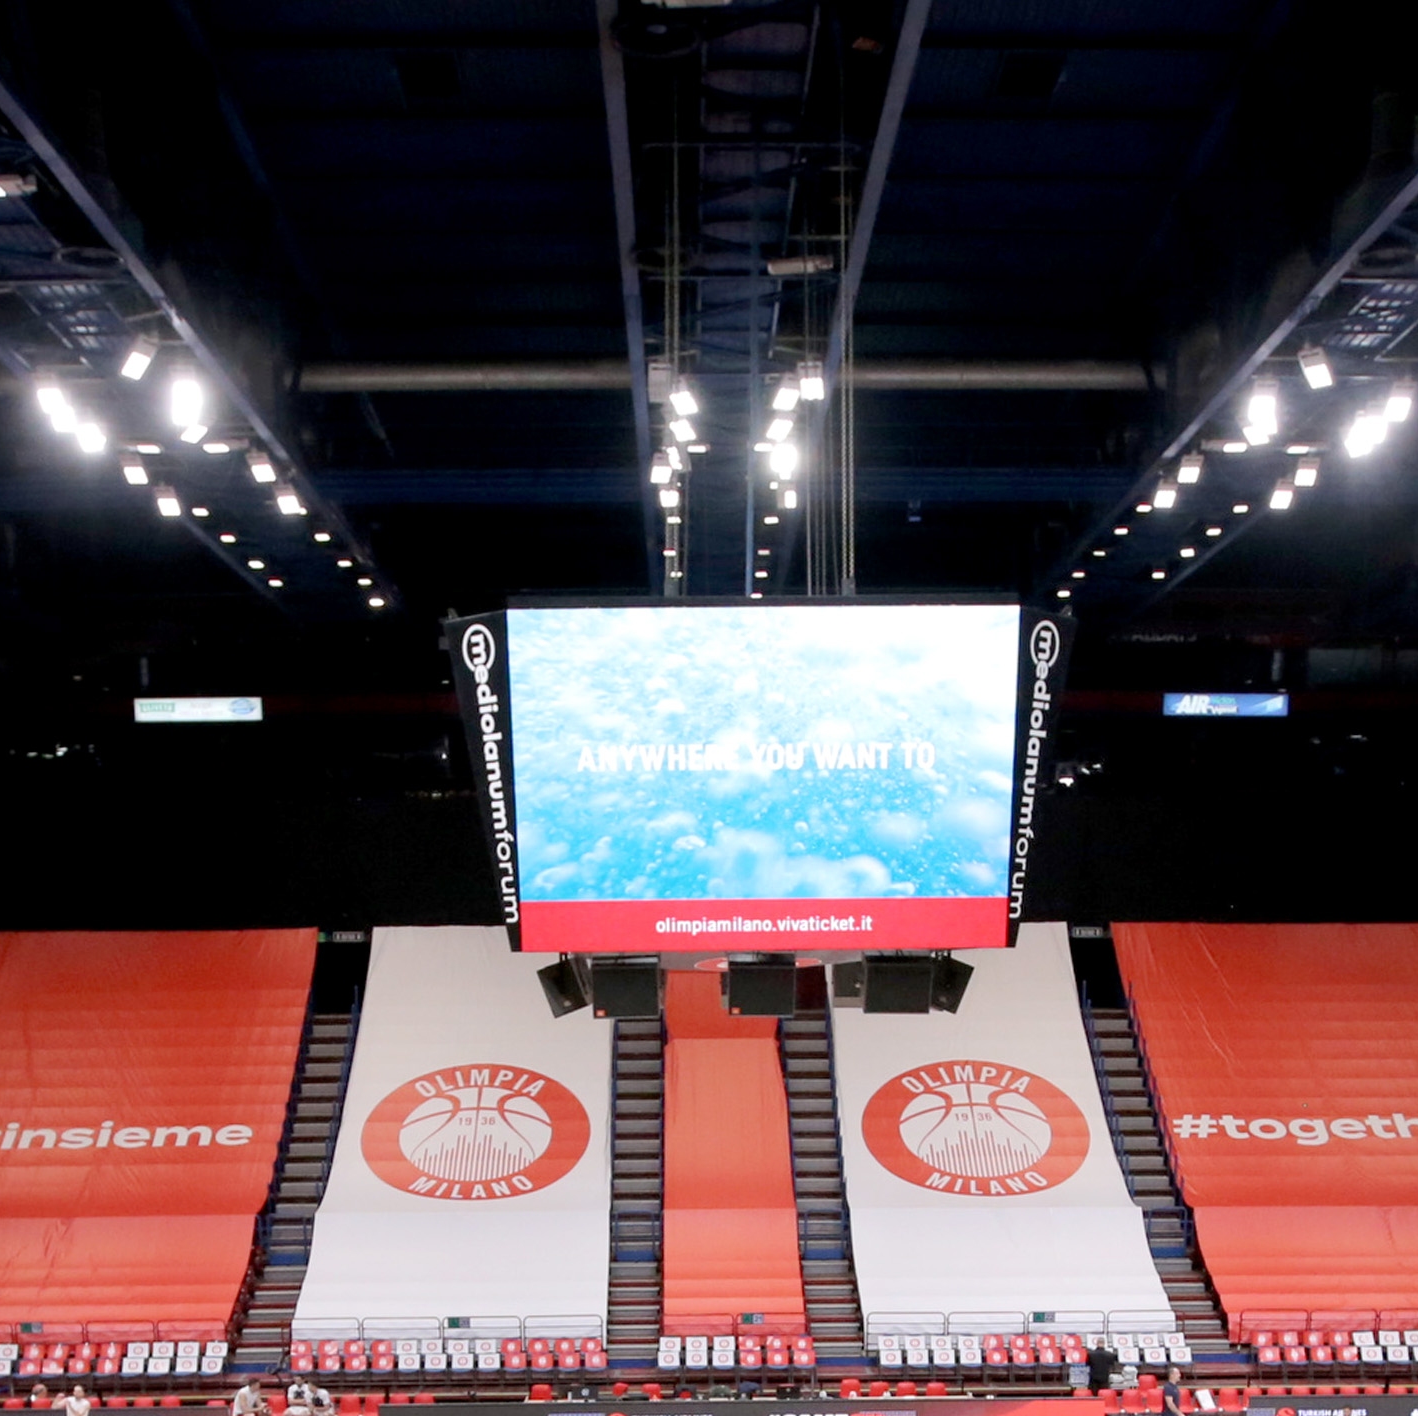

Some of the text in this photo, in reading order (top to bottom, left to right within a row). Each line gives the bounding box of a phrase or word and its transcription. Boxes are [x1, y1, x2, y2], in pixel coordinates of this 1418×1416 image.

[578, 741, 936, 772] ANYWHERE YOU WANT TO
[1008, 618, 1061, 920] mediolanumforum
[462, 622, 519, 925] mediolanumforum
[655, 914, 874, 935] olimpiamilano.vivaticket.it
[414, 1064, 546, 1097] OLIMPIA
[901, 1061, 1031, 1095] OLIMPIA
[409, 1173, 535, 1198] MILANO
[925, 1170, 1048, 1195] MILANO
